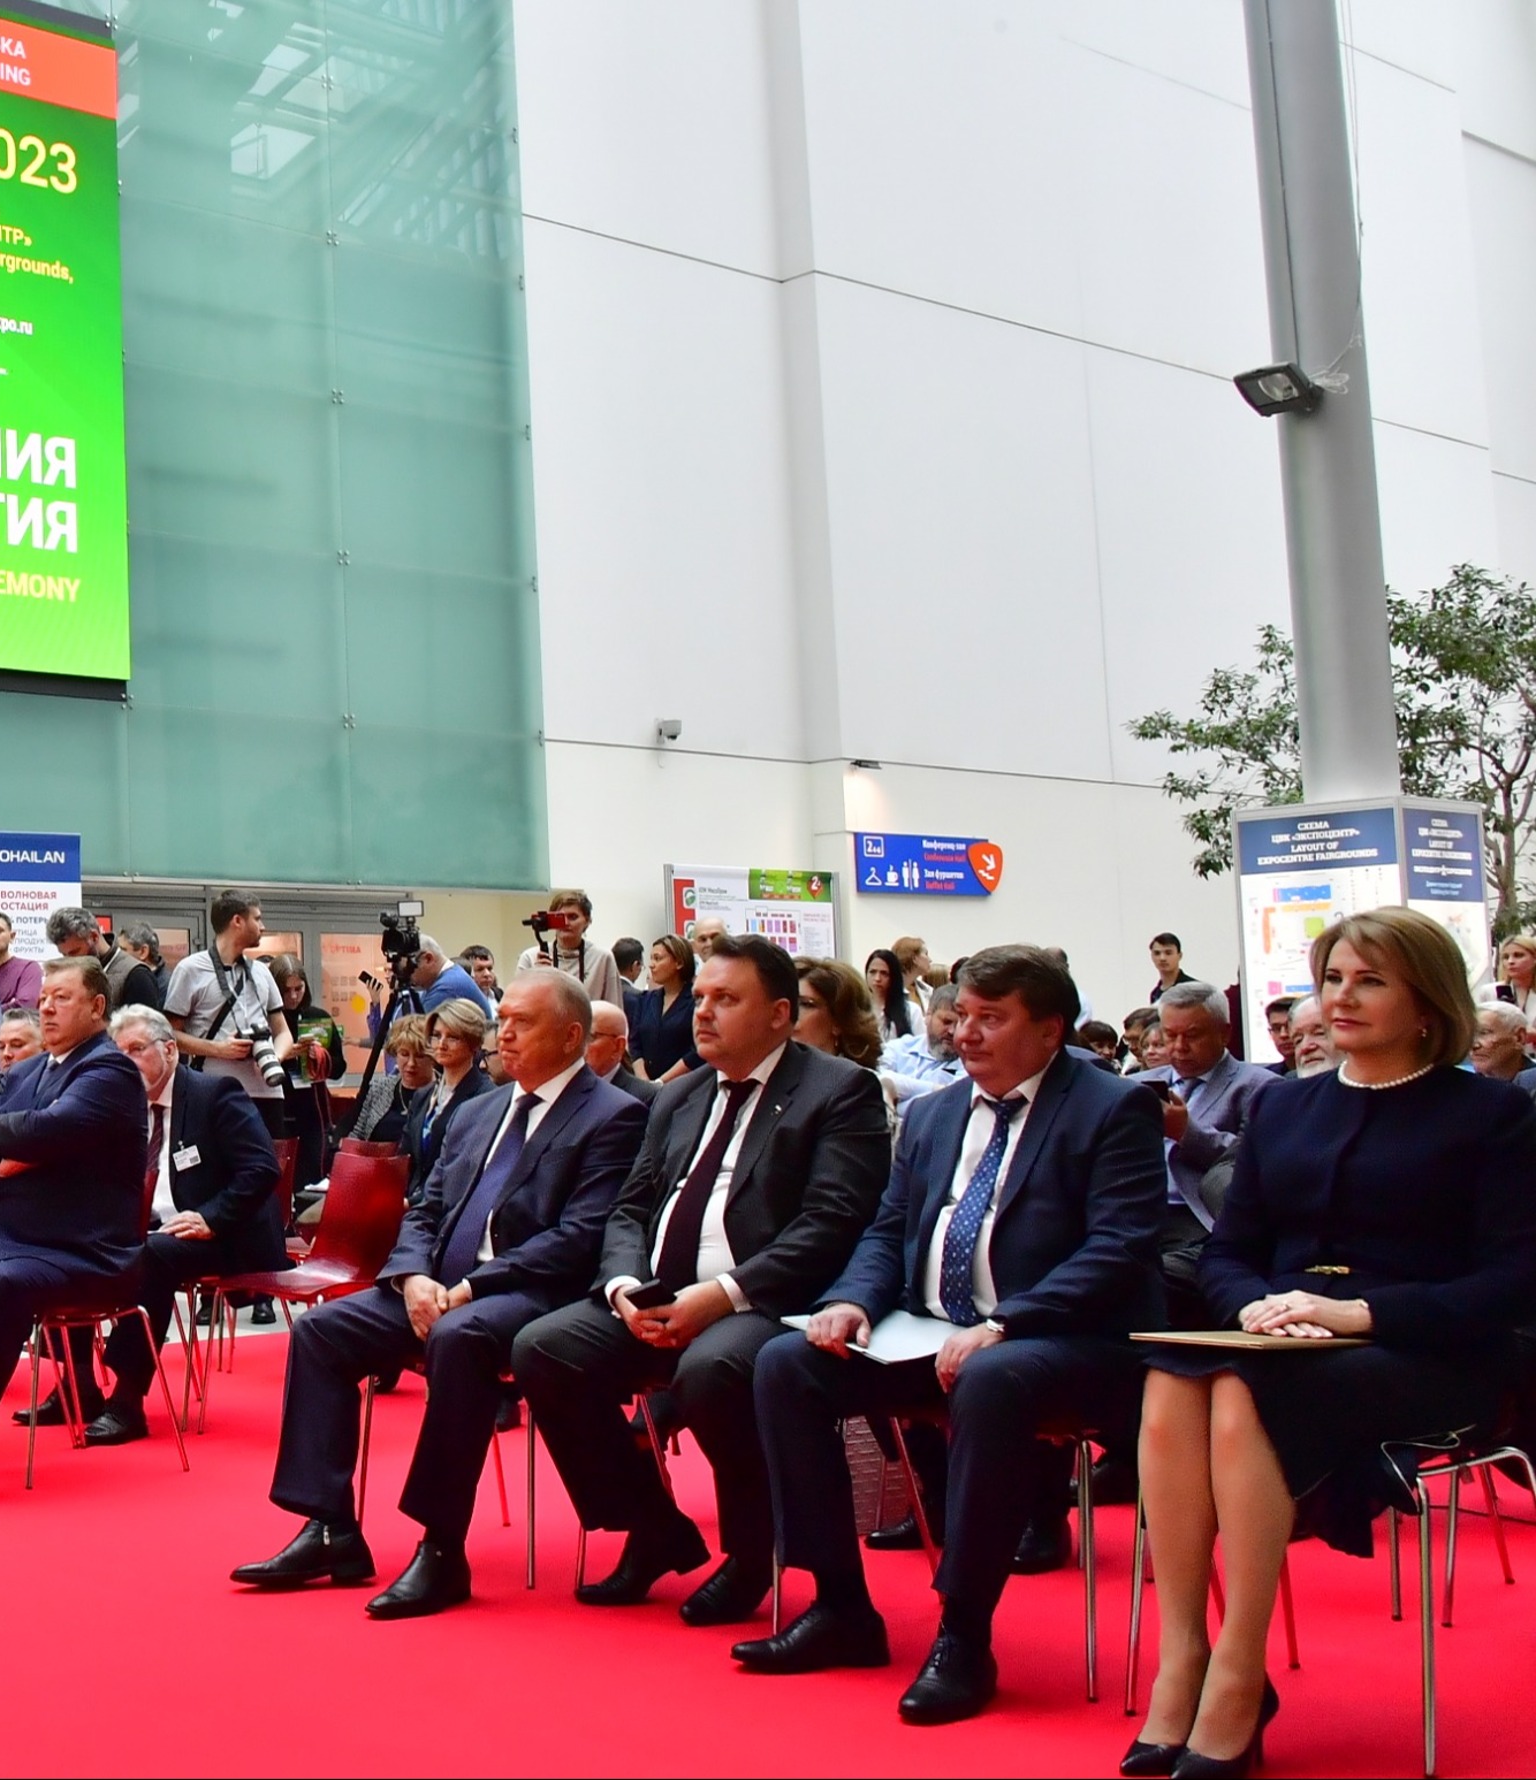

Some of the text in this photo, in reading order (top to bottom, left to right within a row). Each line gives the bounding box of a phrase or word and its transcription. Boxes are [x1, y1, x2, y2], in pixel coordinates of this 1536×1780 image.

[1297, 821, 1330, 831] СХЕМА
[1291, 841, 1339, 853] LAYOUT OF
